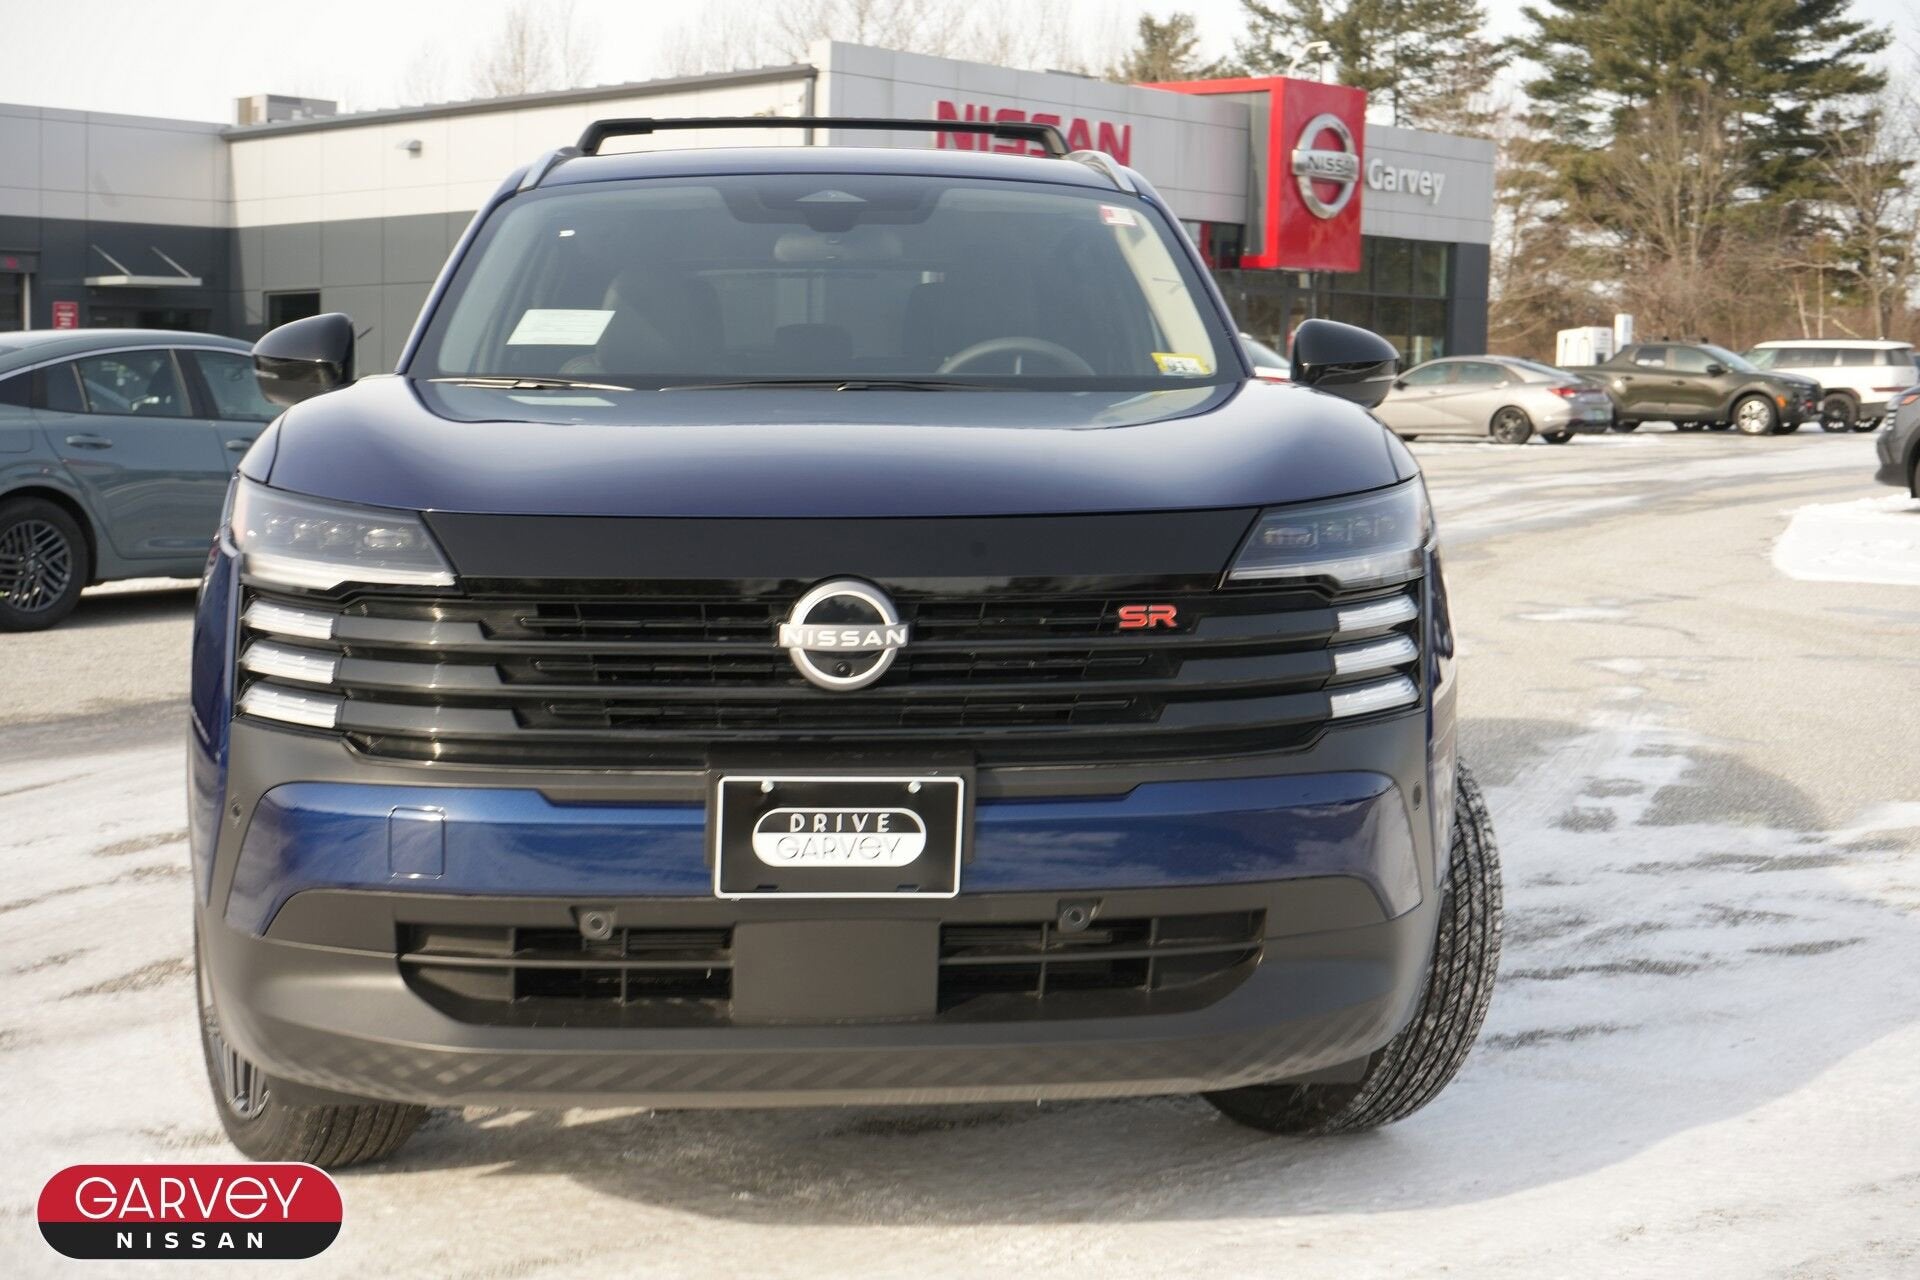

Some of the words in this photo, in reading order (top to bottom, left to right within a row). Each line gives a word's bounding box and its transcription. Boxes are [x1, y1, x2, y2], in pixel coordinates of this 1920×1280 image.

[1368, 159, 1446, 204] Garvey
[1119, 604, 1177, 628] SR
[783, 627, 906, 646] NISSAN
[789, 813, 890, 833] DRIVE
